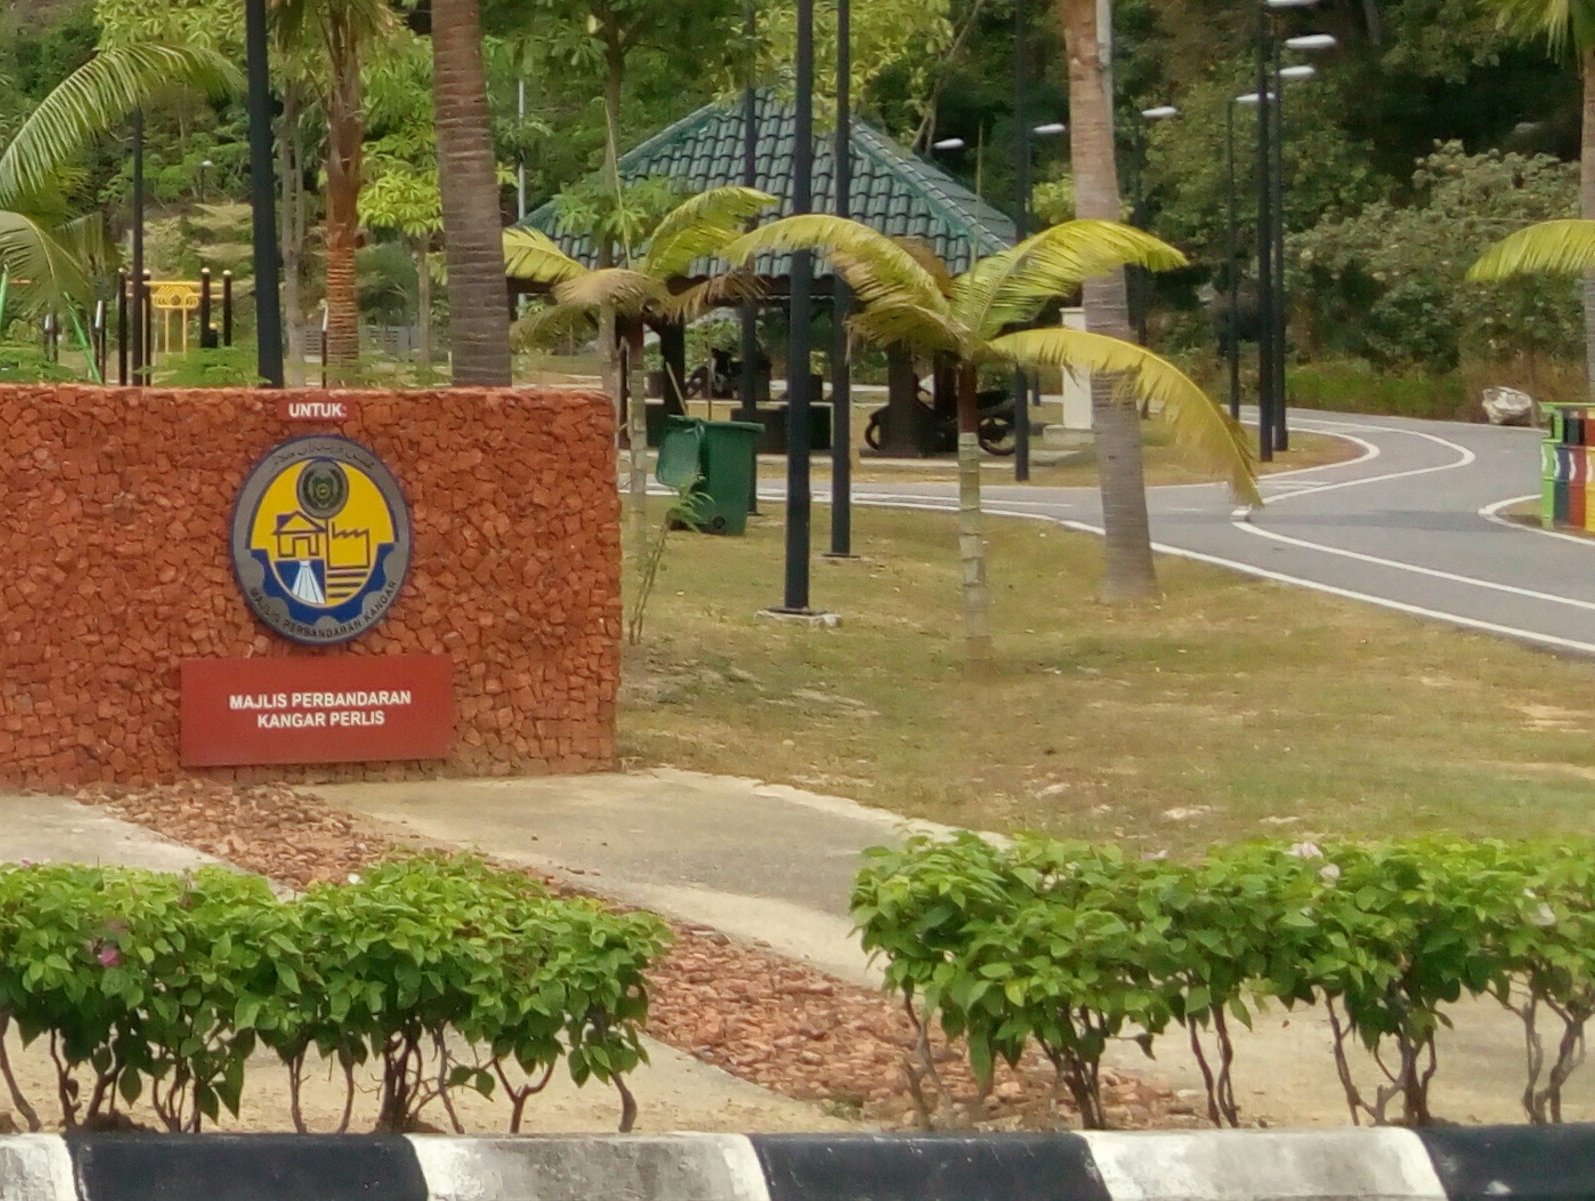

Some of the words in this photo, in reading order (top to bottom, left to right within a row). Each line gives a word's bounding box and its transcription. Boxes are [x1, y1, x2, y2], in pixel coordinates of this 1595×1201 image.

[288, 402, 347, 418] UNTUK:
[229, 693, 288, 710] MAJLIS
[291, 690, 412, 708] PERBANDARAN
[257, 712, 327, 729] KANGAR
[329, 710, 385, 727] PERLIS
